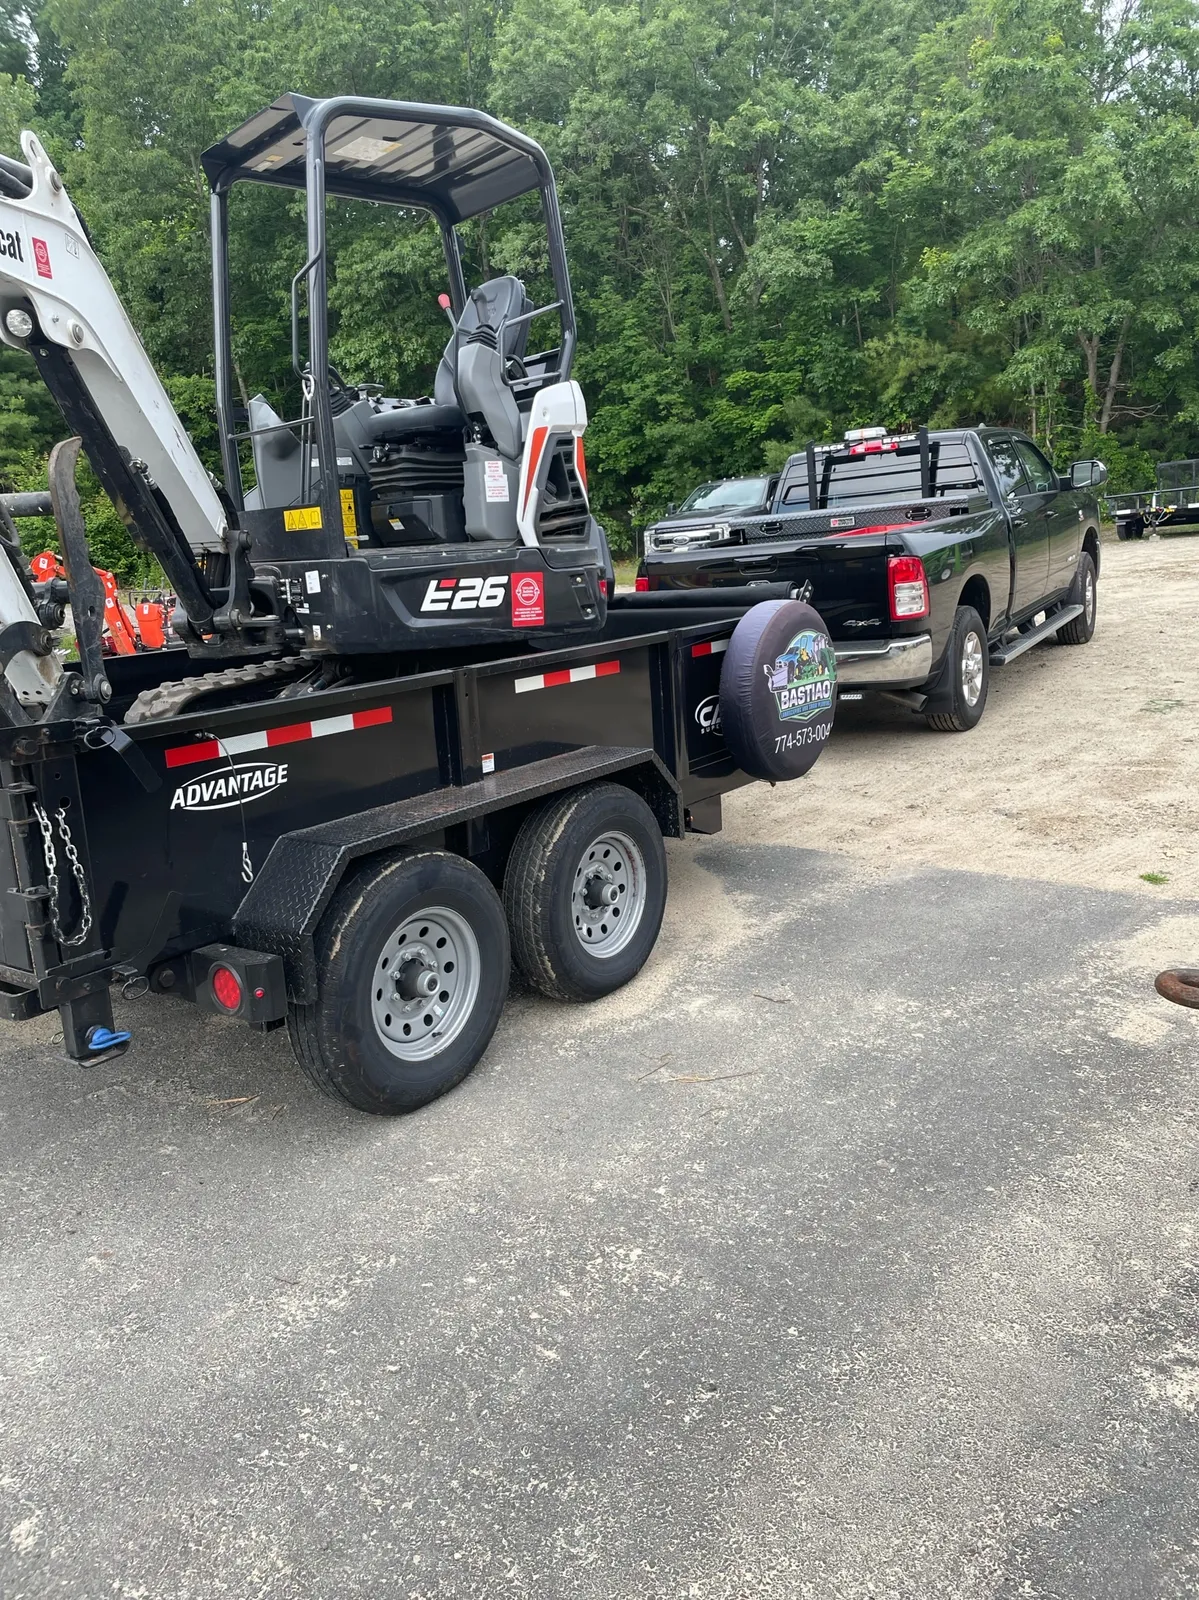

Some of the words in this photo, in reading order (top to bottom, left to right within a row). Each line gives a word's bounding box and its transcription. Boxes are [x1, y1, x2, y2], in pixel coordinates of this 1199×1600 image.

[883, 434, 917, 444] RACK
[420, 576, 509, 612] E26
[781, 680, 831, 710] BASTIAO
[774, 721, 834, 754] 774-573-004
[170, 764, 288, 810] ADVANTAGE
